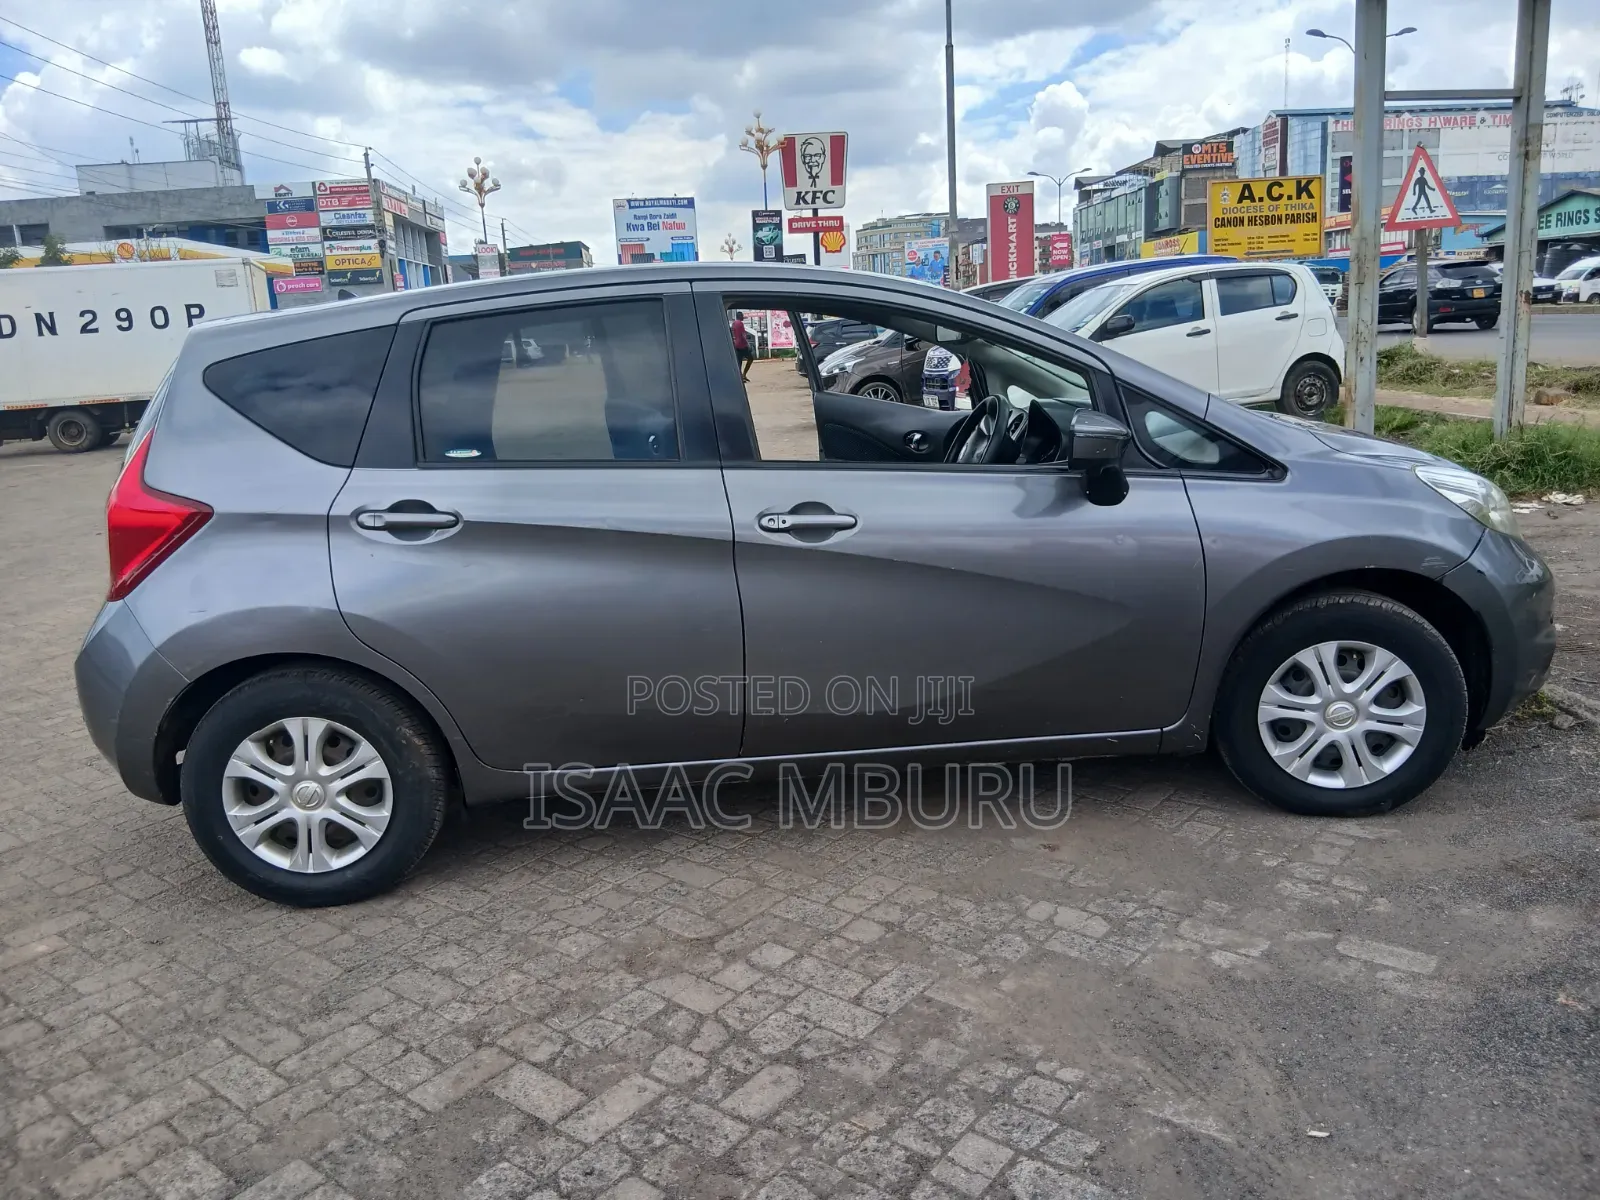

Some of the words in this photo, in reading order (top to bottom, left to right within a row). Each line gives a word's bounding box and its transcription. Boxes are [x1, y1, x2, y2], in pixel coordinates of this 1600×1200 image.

[1384, 118, 1422, 129] RINGS
[1202, 143, 1226, 153] MTS
[1184, 153, 1234, 164] EVENTIVE
[1001, 185, 1020, 193] EXIT
[1237, 180, 1315, 204] A.C.K
[320, 198, 339, 206] DTB
[794, 190, 835, 205] KFC
[1222, 205, 1264, 215] DIOCESE
[1268, 204, 1280, 212] OF
[1284, 203, 1315, 211] THIKA
[334, 212, 367, 220] Cleanfax
[1214, 216, 1244, 228] CANON
[1247, 214, 1282, 227] HESBON
[1285, 212, 1317, 225] PARISH
[1556, 209, 1590, 228] RINGS
[626, 222, 645, 232] Kwa
[647, 221, 660, 231] Bei
[662, 221, 686, 231] Nafuu
[792, 221, 816, 229] DRIVE
[335, 258, 367, 266] OPTICA
[287, 282, 306, 290] peach
